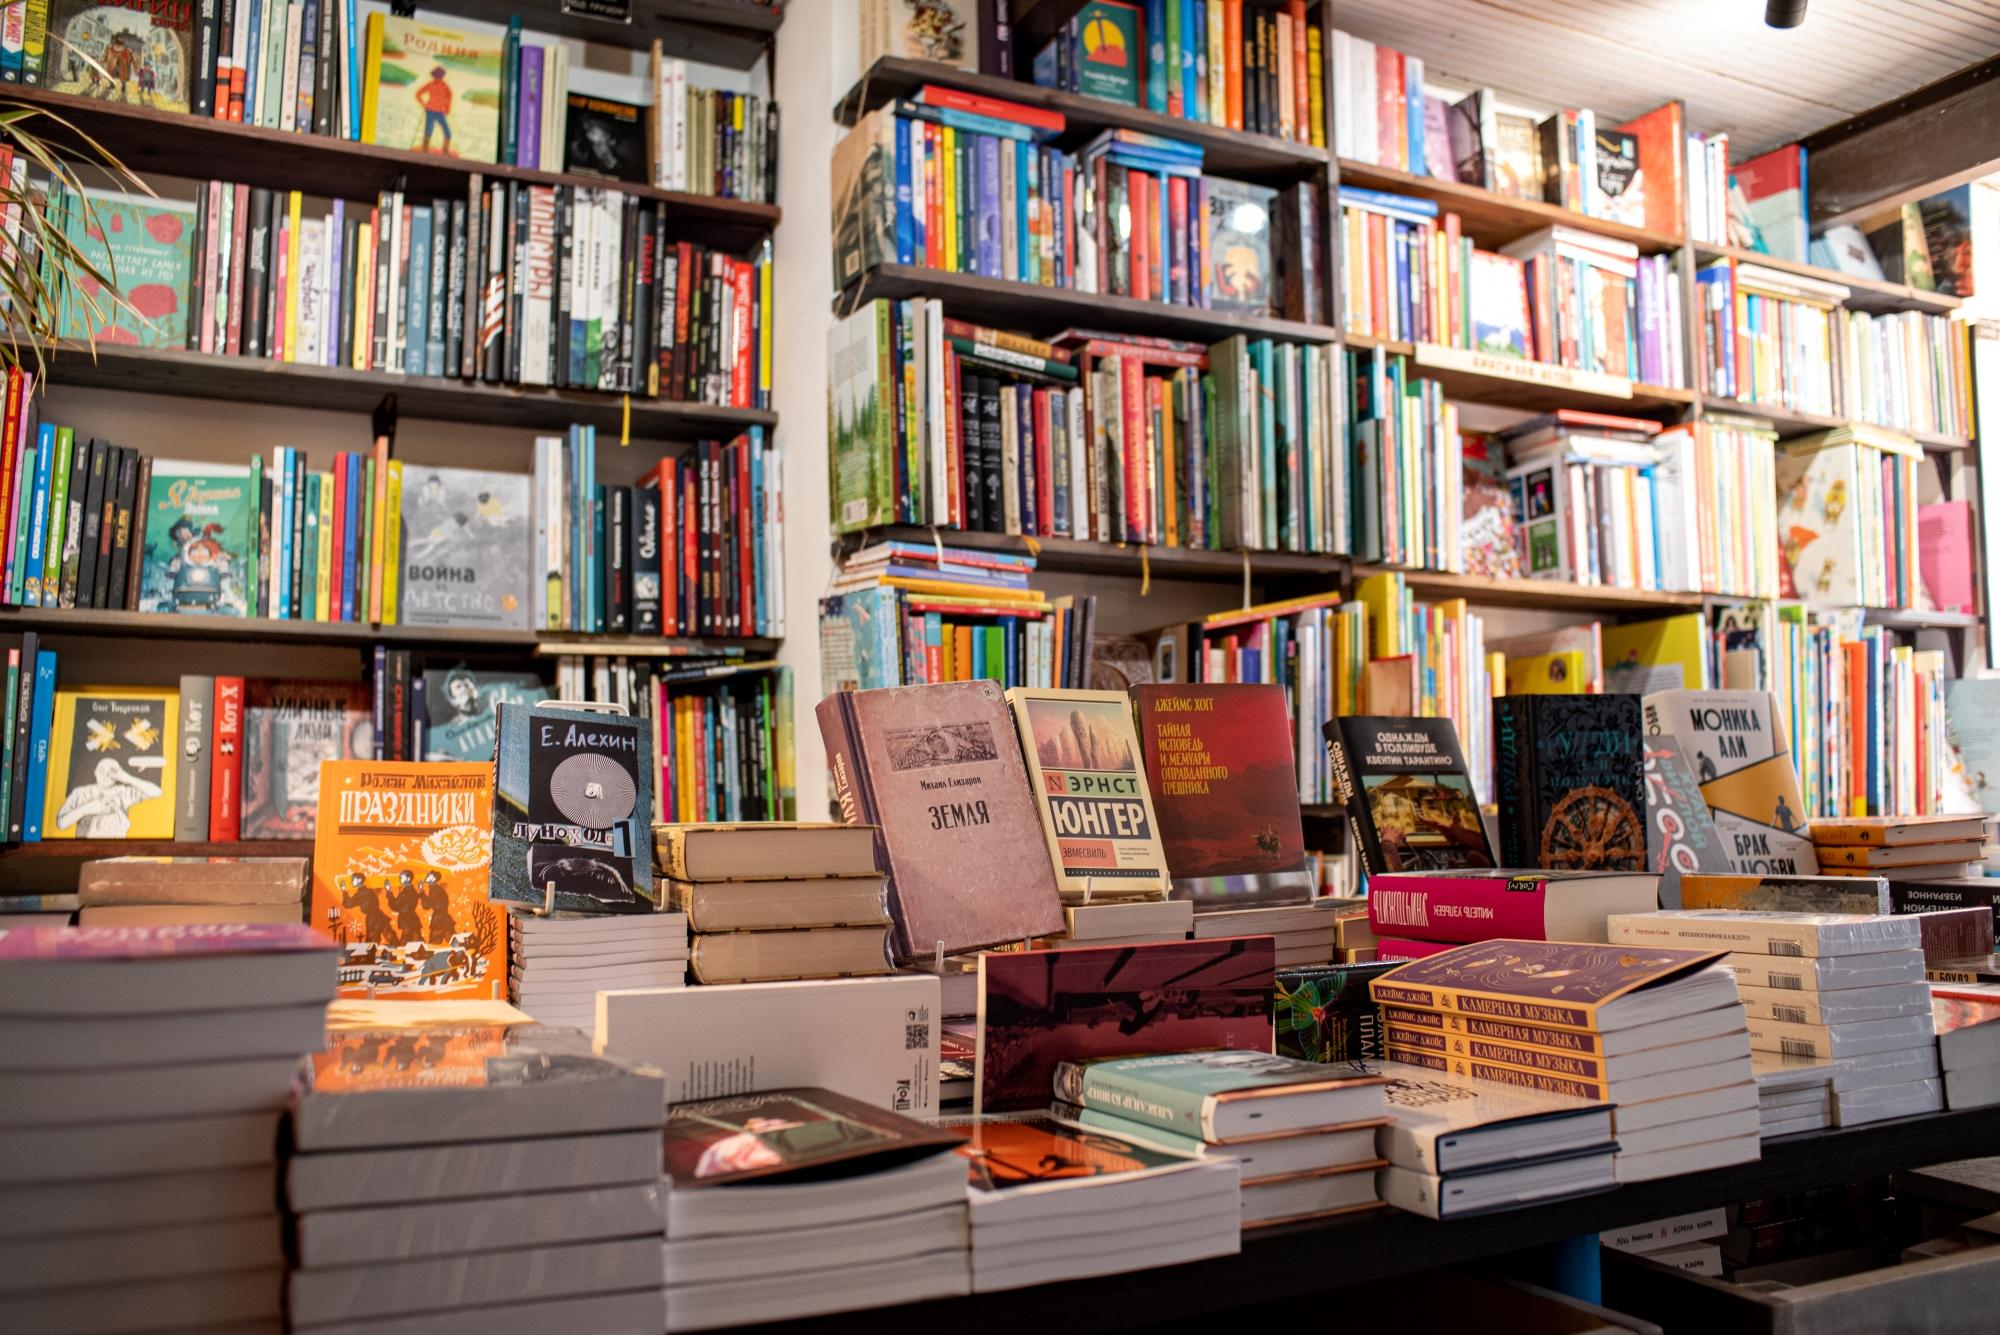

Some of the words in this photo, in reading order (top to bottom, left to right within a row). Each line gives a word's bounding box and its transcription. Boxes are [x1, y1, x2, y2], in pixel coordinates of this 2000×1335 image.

[1154, 697, 1192, 712] ДЖЕЙМС
[1194, 698, 1213, 712] ХОГГ
[1690, 708, 1761, 732] МОНИКА
[564, 724, 637, 752] Алехин
[1157, 723, 1191, 738] ТАЙНАЯ
[1377, 732, 1429, 743] ОДНАЖДЫ
[1158, 739, 1203, 752] ИСПОВЕДЬ
[1375, 743, 1382, 752] В
[1383, 743, 1437, 754] ГОЛЛИВУДЕ
[1719, 737, 1748, 758] АЛИ
[1159, 753, 1166, 766] И
[1168, 753, 1211, 766] МЕМУАРЫ
[1366, 755, 1403, 765] КВЕНТИН
[1405, 756, 1452, 766] ТАРАНТИНО
[1161, 767, 1228, 781] ОПРАВДАННОГО
[1333, 741, 1354, 798] ОДНАЖДЫ
[360, 772, 406, 789] Роман
[412, 773, 486, 790] Михайлов
[919, 777, 947, 791] Михаил
[948, 775, 982, 789] Елизаров
[1070, 775, 1138, 793] ЭРНСТ
[1162, 781, 1210, 796] ГРЕШНИКА
[339, 790, 476, 825] ПРАЗДНИКИ
[928, 800, 990, 830] ЗЕМЛЯ
[1054, 801, 1145, 836] ЮНГЕР
[1062, 847, 1107, 859] ЭВМЕСВИЛЬ
[1735, 834, 1769, 856] БРАК
[1908, 890, 1962, 901] ИЗБРАННОЕ
[1373, 889, 1429, 927] УНИЧТОЖИТЬ
[1433, 905, 1462, 917] УЭЛЬБЕК
[1463, 905, 1494, 919] МИШЕЛЬ
[1376, 988, 1405, 1001] ДЖЕЙМС
[1406, 990, 1431, 1004] ДЖОЙС
[1461, 998, 1521, 1018] КАМЕРНАЯ
[1525, 1005, 1574, 1025] МУЗЫКА
[1388, 1009, 1415, 1022] ДЖЕЙМС
[1416, 1012, 1440, 1026] ДЖОЙС
[1471, 1022, 1531, 1042] КАМЕРНАЯ
[1533, 1030, 1582, 1050] МУЗЫКА
[1391, 1029, 1418, 1043] ДЖЕЙМС
[1419, 1033, 1443, 1048] ДЖОЙС
[1473, 1045, 1533, 1066] КАМЕРНАЯ
[1536, 1054, 1584, 1075] МУЗЫКА
[1393, 1050, 1420, 1066] ДЖЕЙМС
[1421, 1055, 1446, 1070] ДЖОЙС
[1476, 1066, 1534, 1087] КАМЕРНАЯ
[1538, 1075, 1587, 1097] МУЗЫКА
